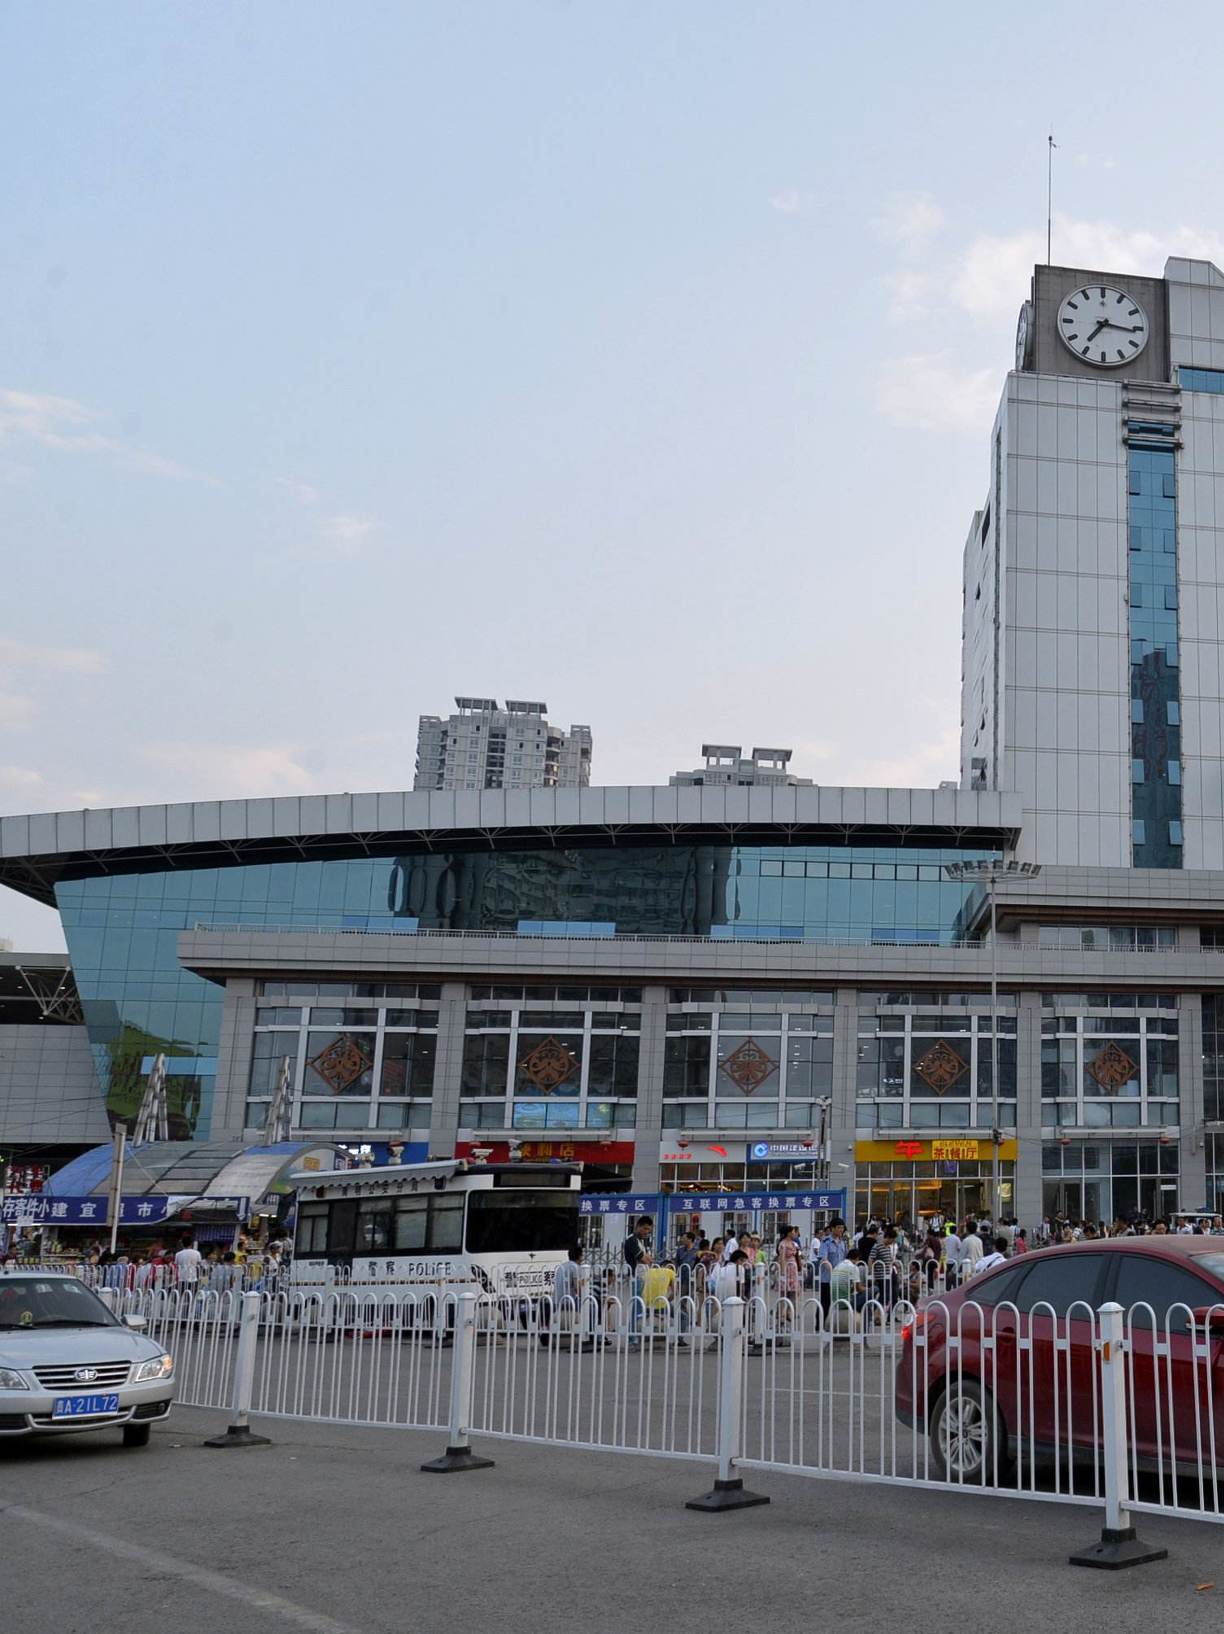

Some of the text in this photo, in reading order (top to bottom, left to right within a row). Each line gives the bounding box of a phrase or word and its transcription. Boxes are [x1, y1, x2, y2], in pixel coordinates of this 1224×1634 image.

[581, 1199, 646, 1213] 换票专区
[682, 1195, 830, 1211] 互联网急客换票专区
